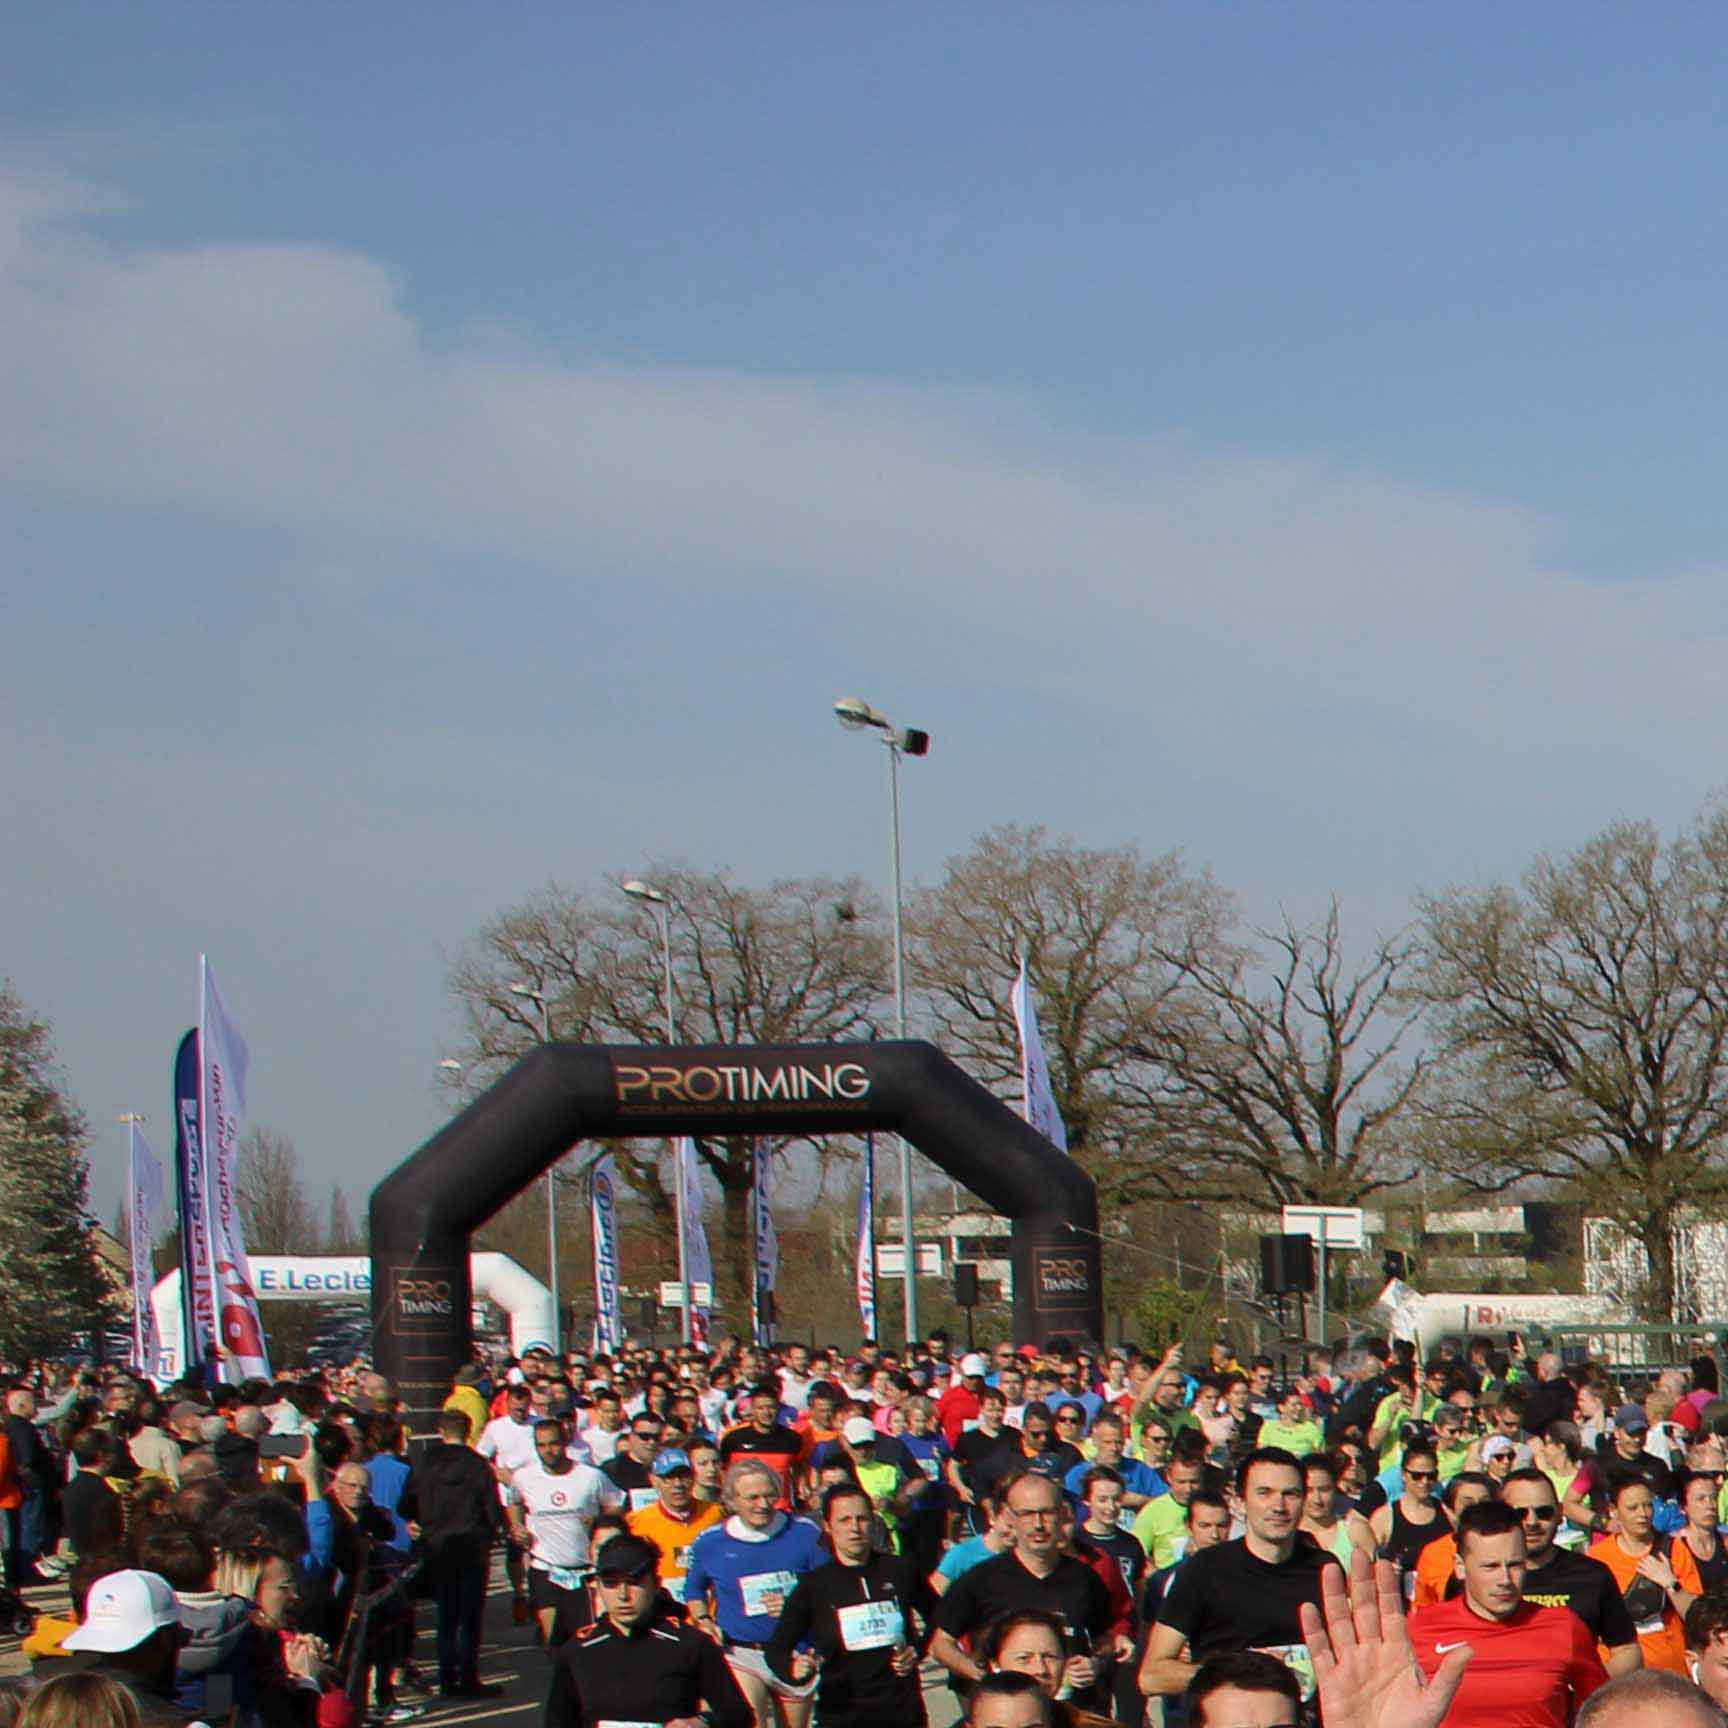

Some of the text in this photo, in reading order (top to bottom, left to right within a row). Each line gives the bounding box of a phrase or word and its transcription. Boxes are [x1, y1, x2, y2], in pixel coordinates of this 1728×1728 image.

[616, 1063, 870, 1101] PROTIMING
[1039, 1259, 1087, 1275] PRO
[398, 1280, 450, 1299] PRO
[1041, 1277, 1089, 1291] TIMING
[400, 1299, 452, 1314] TIMING
